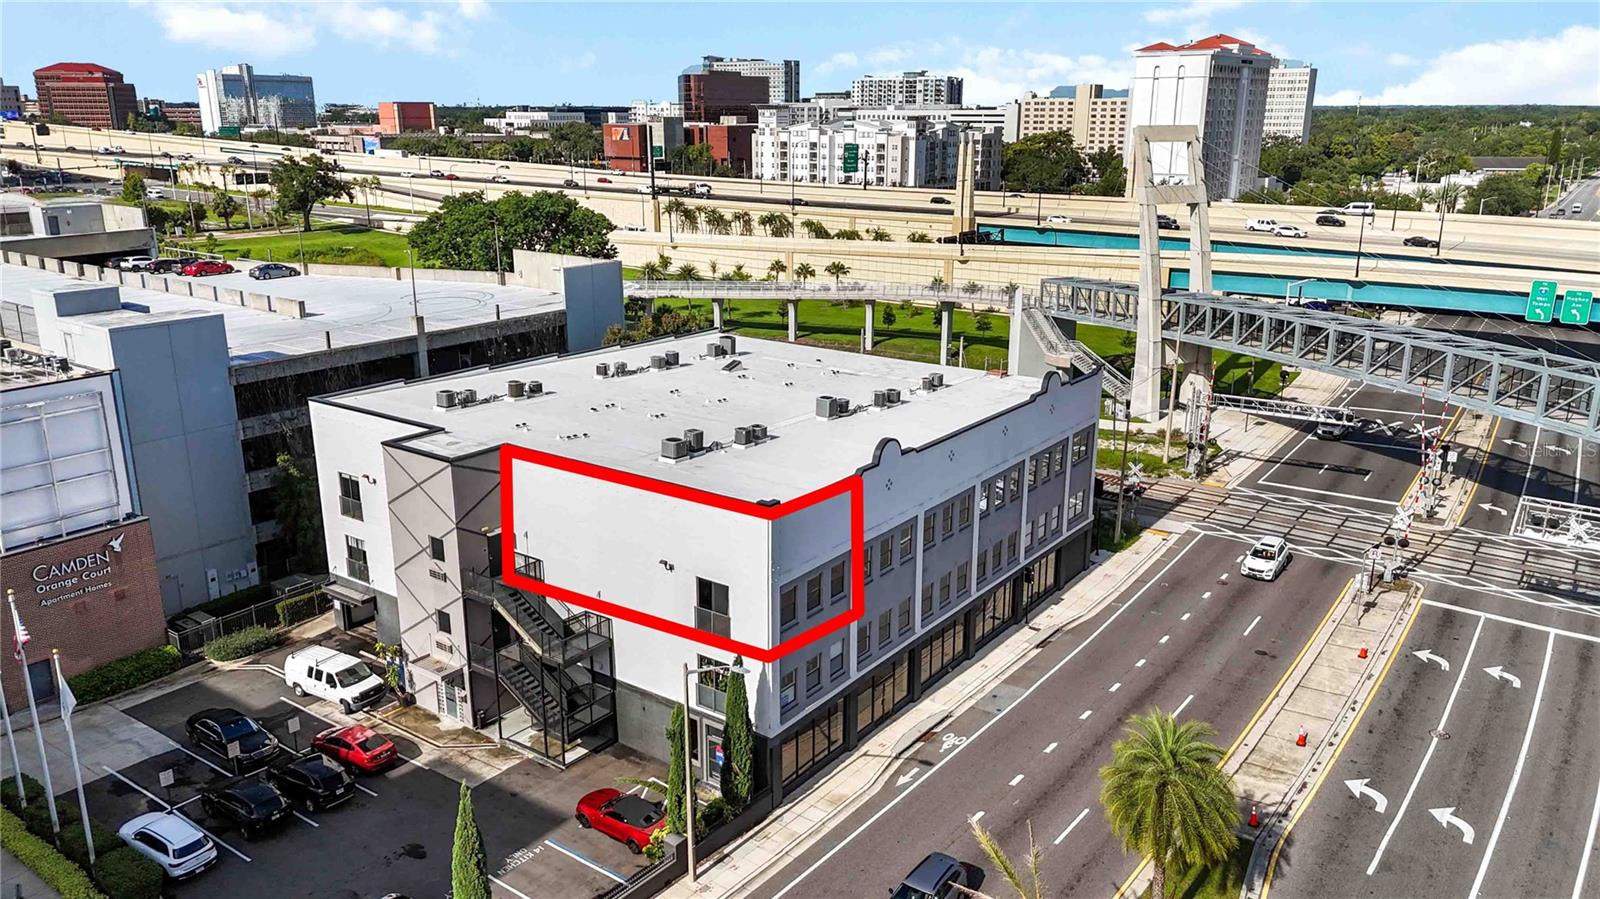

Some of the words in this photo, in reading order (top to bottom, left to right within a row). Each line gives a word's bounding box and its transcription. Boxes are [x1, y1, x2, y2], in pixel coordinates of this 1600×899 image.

[32, 550, 110, 582] CAMDEN
[36, 577, 78, 594] Orange
[82, 566, 112, 581] Court
[40, 588, 84, 607] Apartment
[85, 581, 113, 594] Homes
[497, 851, 534, 876] KITCHEN
[504, 848, 527, 864] ONLY
